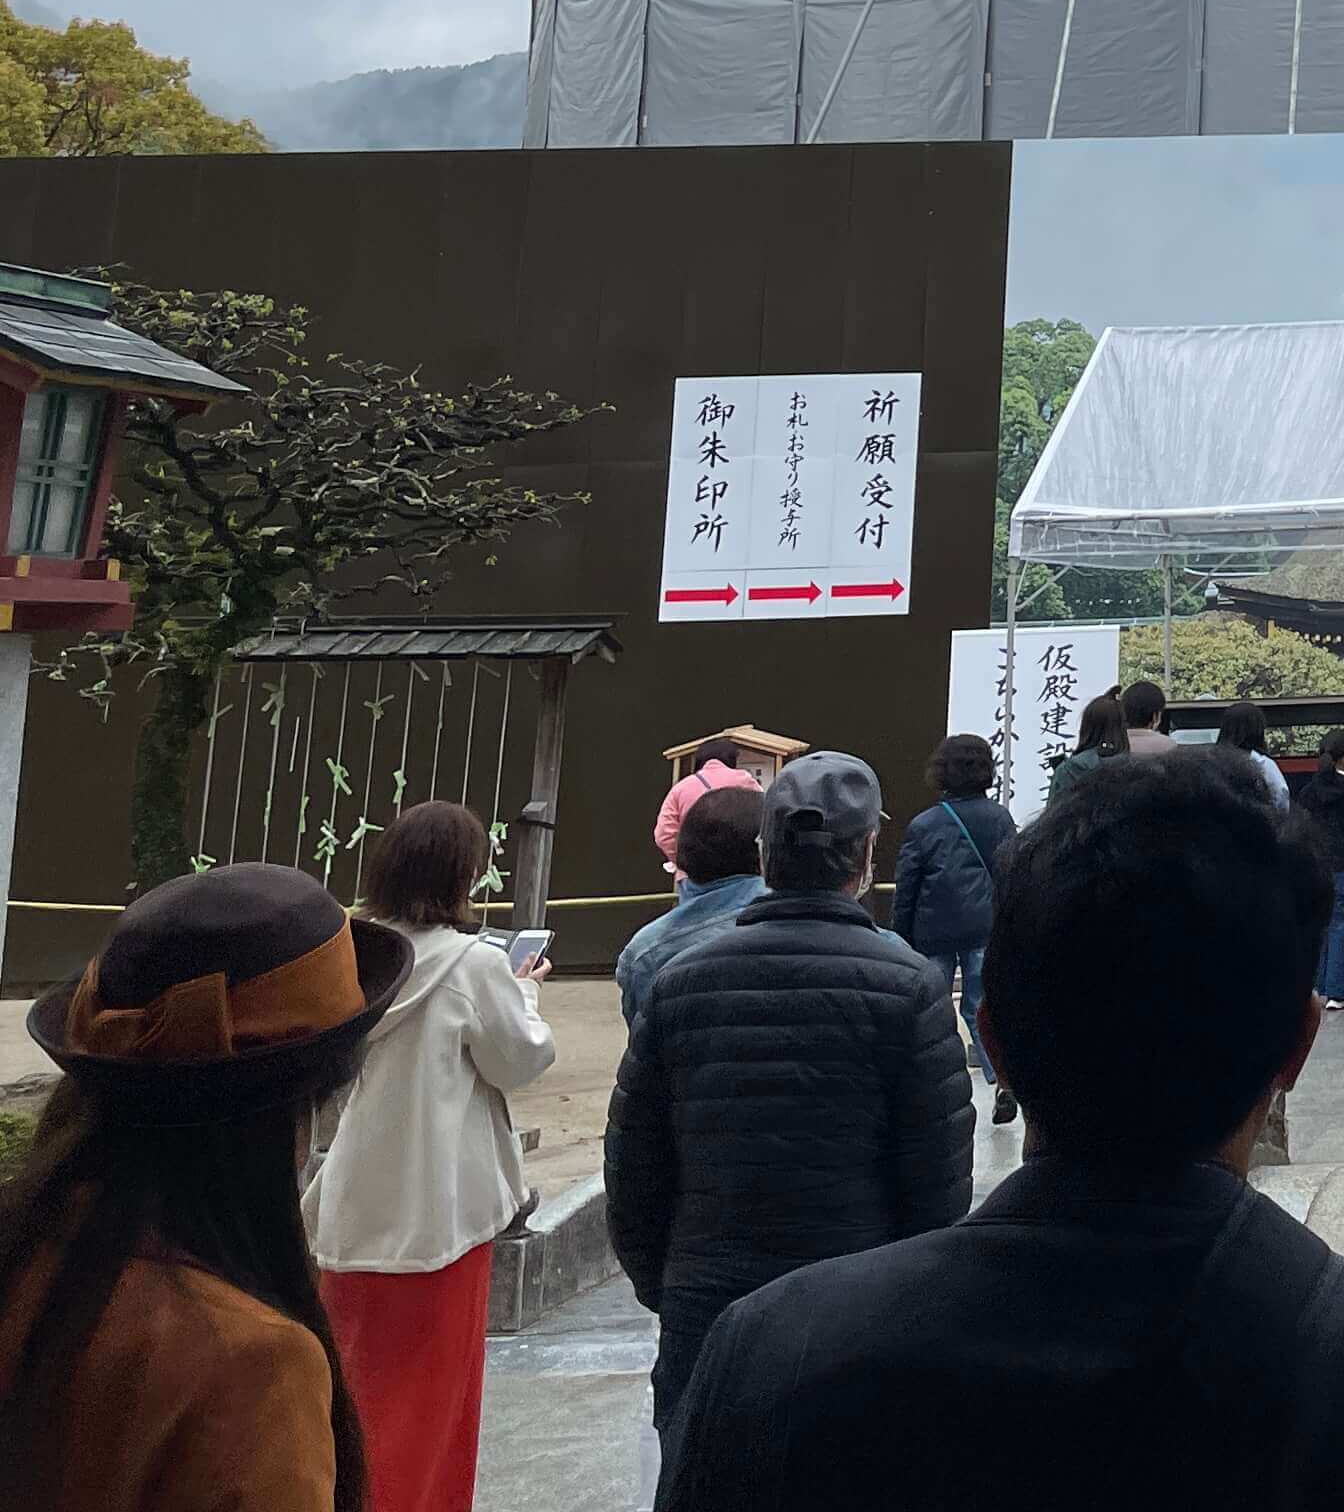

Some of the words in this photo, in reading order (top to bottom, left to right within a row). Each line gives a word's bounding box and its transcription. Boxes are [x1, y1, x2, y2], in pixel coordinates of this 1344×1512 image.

[690, 394, 735, 553] 御朱印所
[854, 389, 900, 549] 祈願受付
